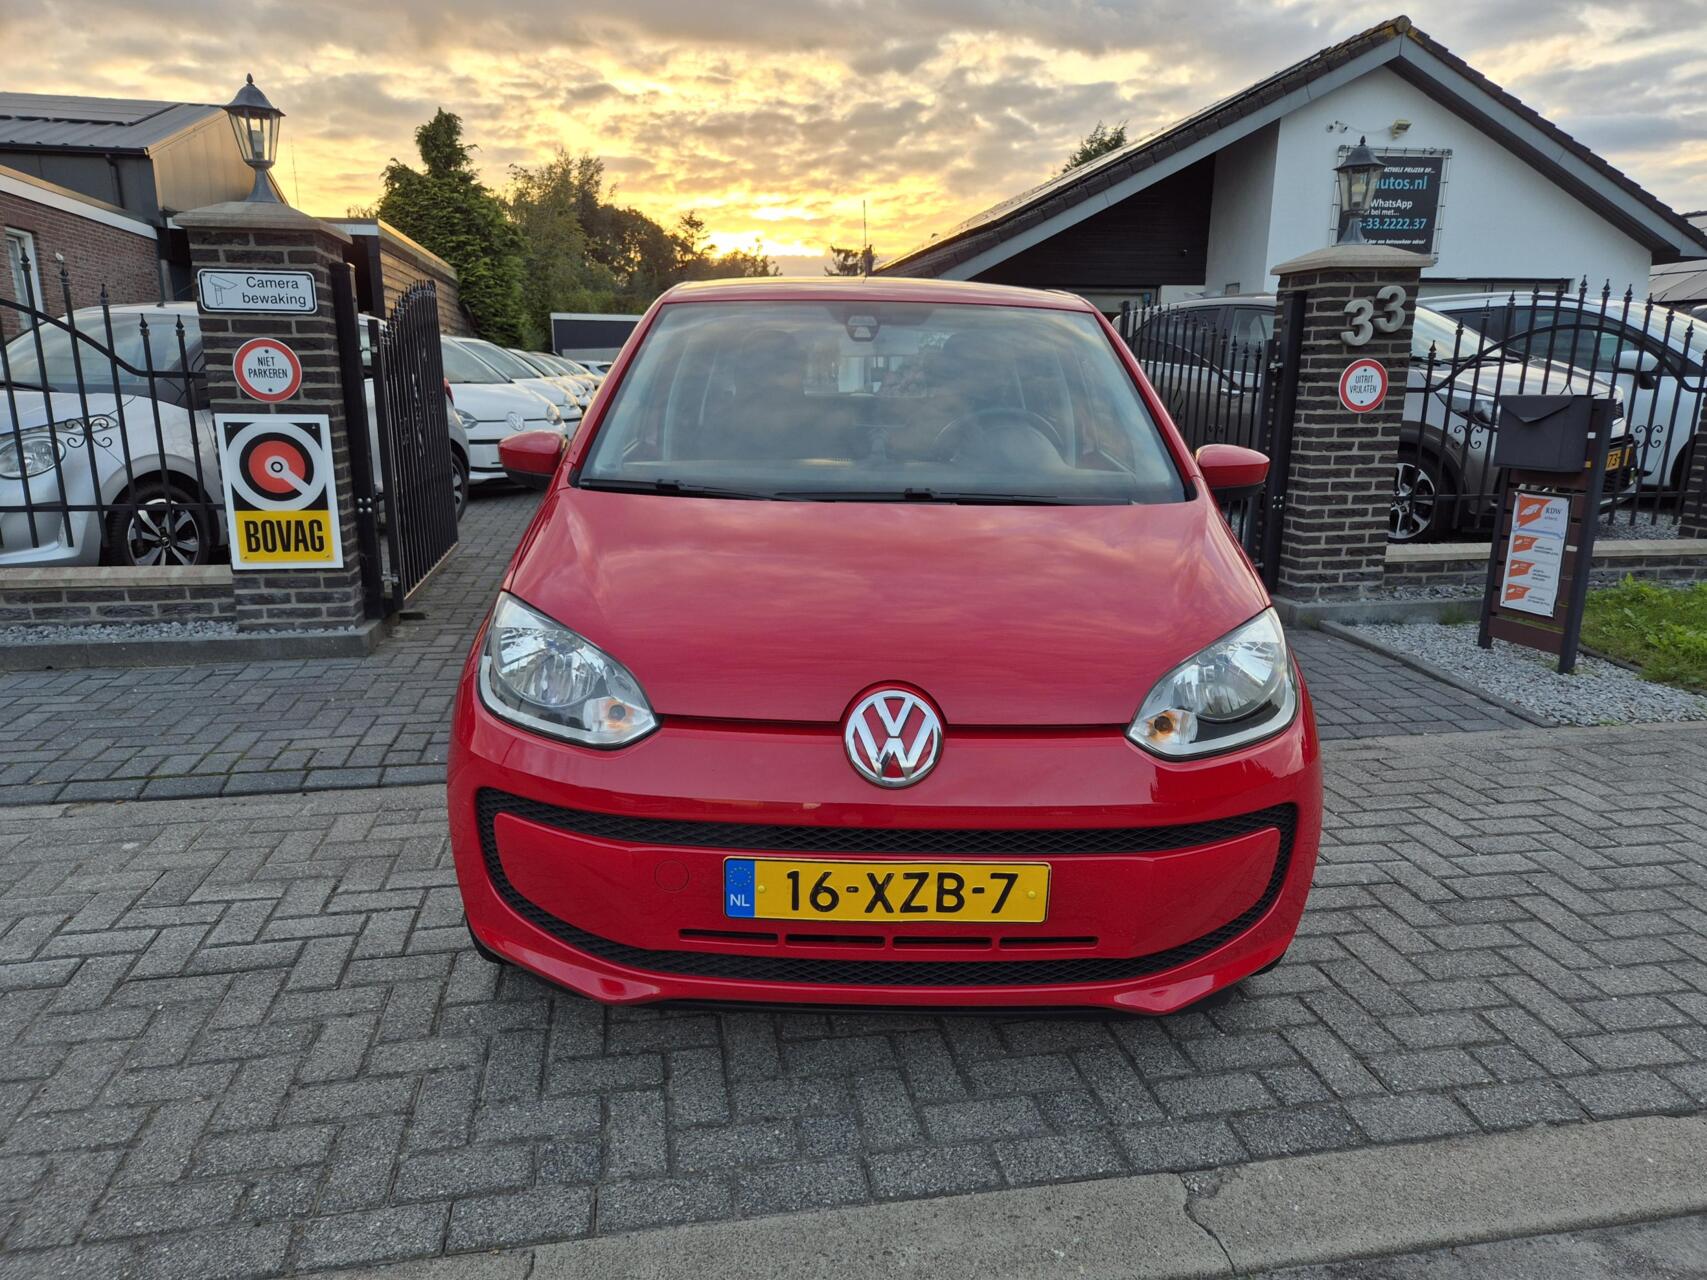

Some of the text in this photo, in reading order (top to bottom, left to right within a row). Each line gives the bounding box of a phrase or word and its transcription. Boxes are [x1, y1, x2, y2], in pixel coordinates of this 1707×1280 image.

[1371, 199, 1413, 210] WhatsApp
[246, 276, 299, 289] Camera
[242, 292, 306, 307] bewaking
[1341, 285, 1407, 346] 33
[257, 356, 275, 366] NIET
[248, 368, 288, 379] PARKEREN
[1355, 375, 1374, 384] UITRIT
[244, 519, 325, 553] BOVAG
[786, 870, 1019, 914] 16-XZB-7
[729, 893, 750, 907] NL
